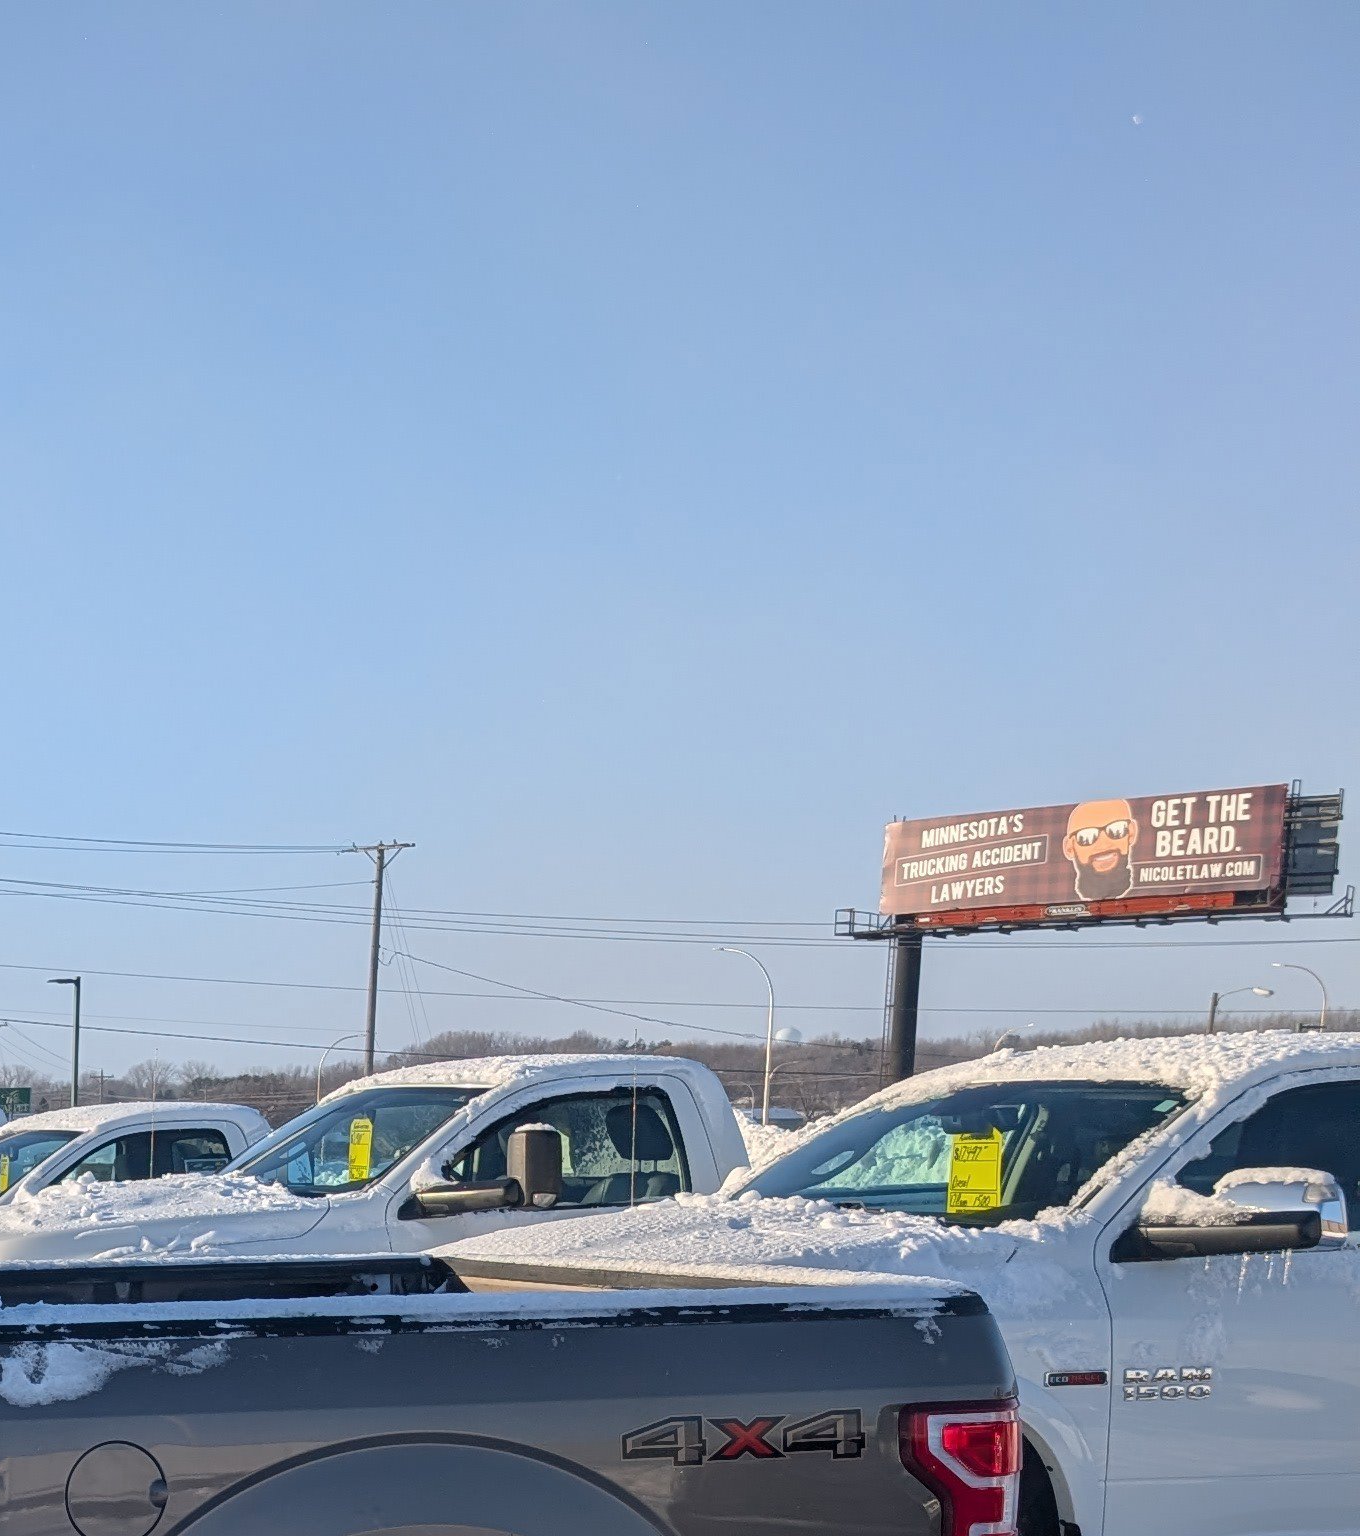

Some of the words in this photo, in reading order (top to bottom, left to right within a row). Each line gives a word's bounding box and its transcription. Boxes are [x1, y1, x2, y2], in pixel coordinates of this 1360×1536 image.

[1151, 796, 1197, 828] GET
[1206, 792, 1252, 824] THE
[921, 813, 1024, 848] MINNESOTA'S
[1155, 825, 1242, 857] BEARD.
[902, 853, 968, 880] TRUCKING
[972, 841, 1042, 869] ACCIDENT
[1139, 860, 1256, 882] NICOLETLAW.COM
[930, 875, 1005, 904] LAWYERS
[1123, 1366, 1213, 1383] RAM
[1123, 1384, 1212, 1401] 1500
